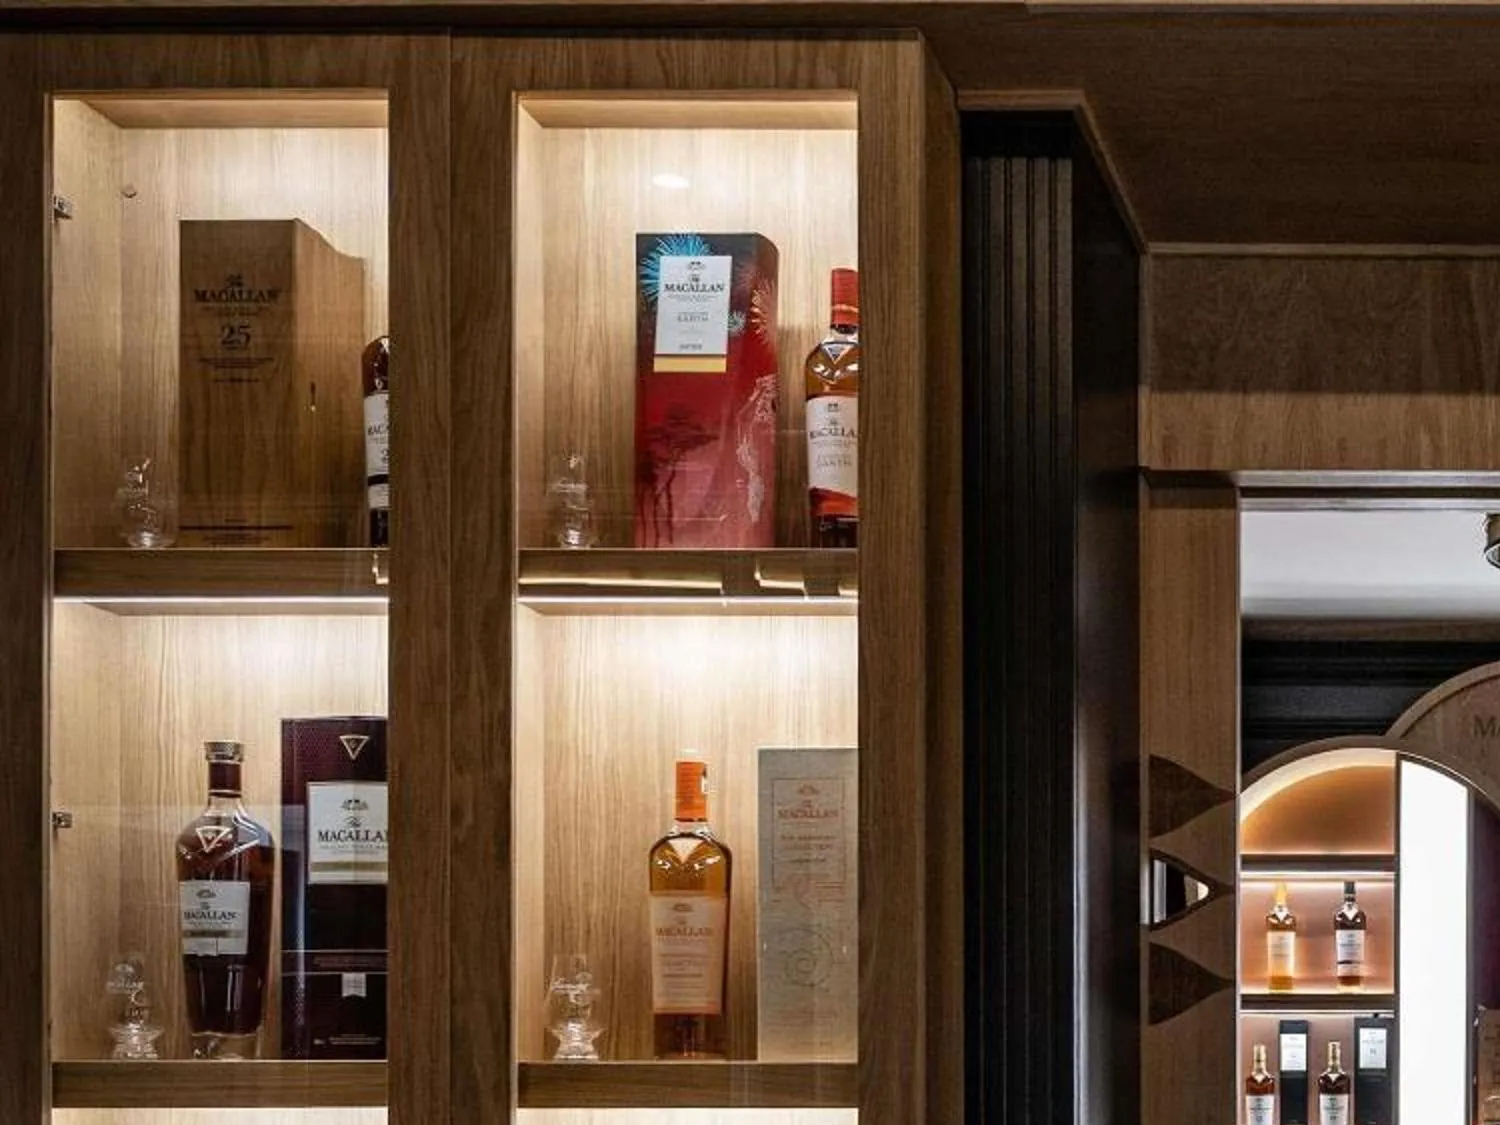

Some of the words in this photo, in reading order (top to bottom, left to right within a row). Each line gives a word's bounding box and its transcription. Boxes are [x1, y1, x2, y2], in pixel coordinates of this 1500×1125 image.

[194, 288, 281, 302] MACALLAN
[664, 283, 725, 293] MACALLAN
[221, 325, 251, 346] 25
[809, 425, 857, 440] MACALLA
[318, 829, 387, 843] MACALLA
[183, 911, 239, 921] MACALLAN
